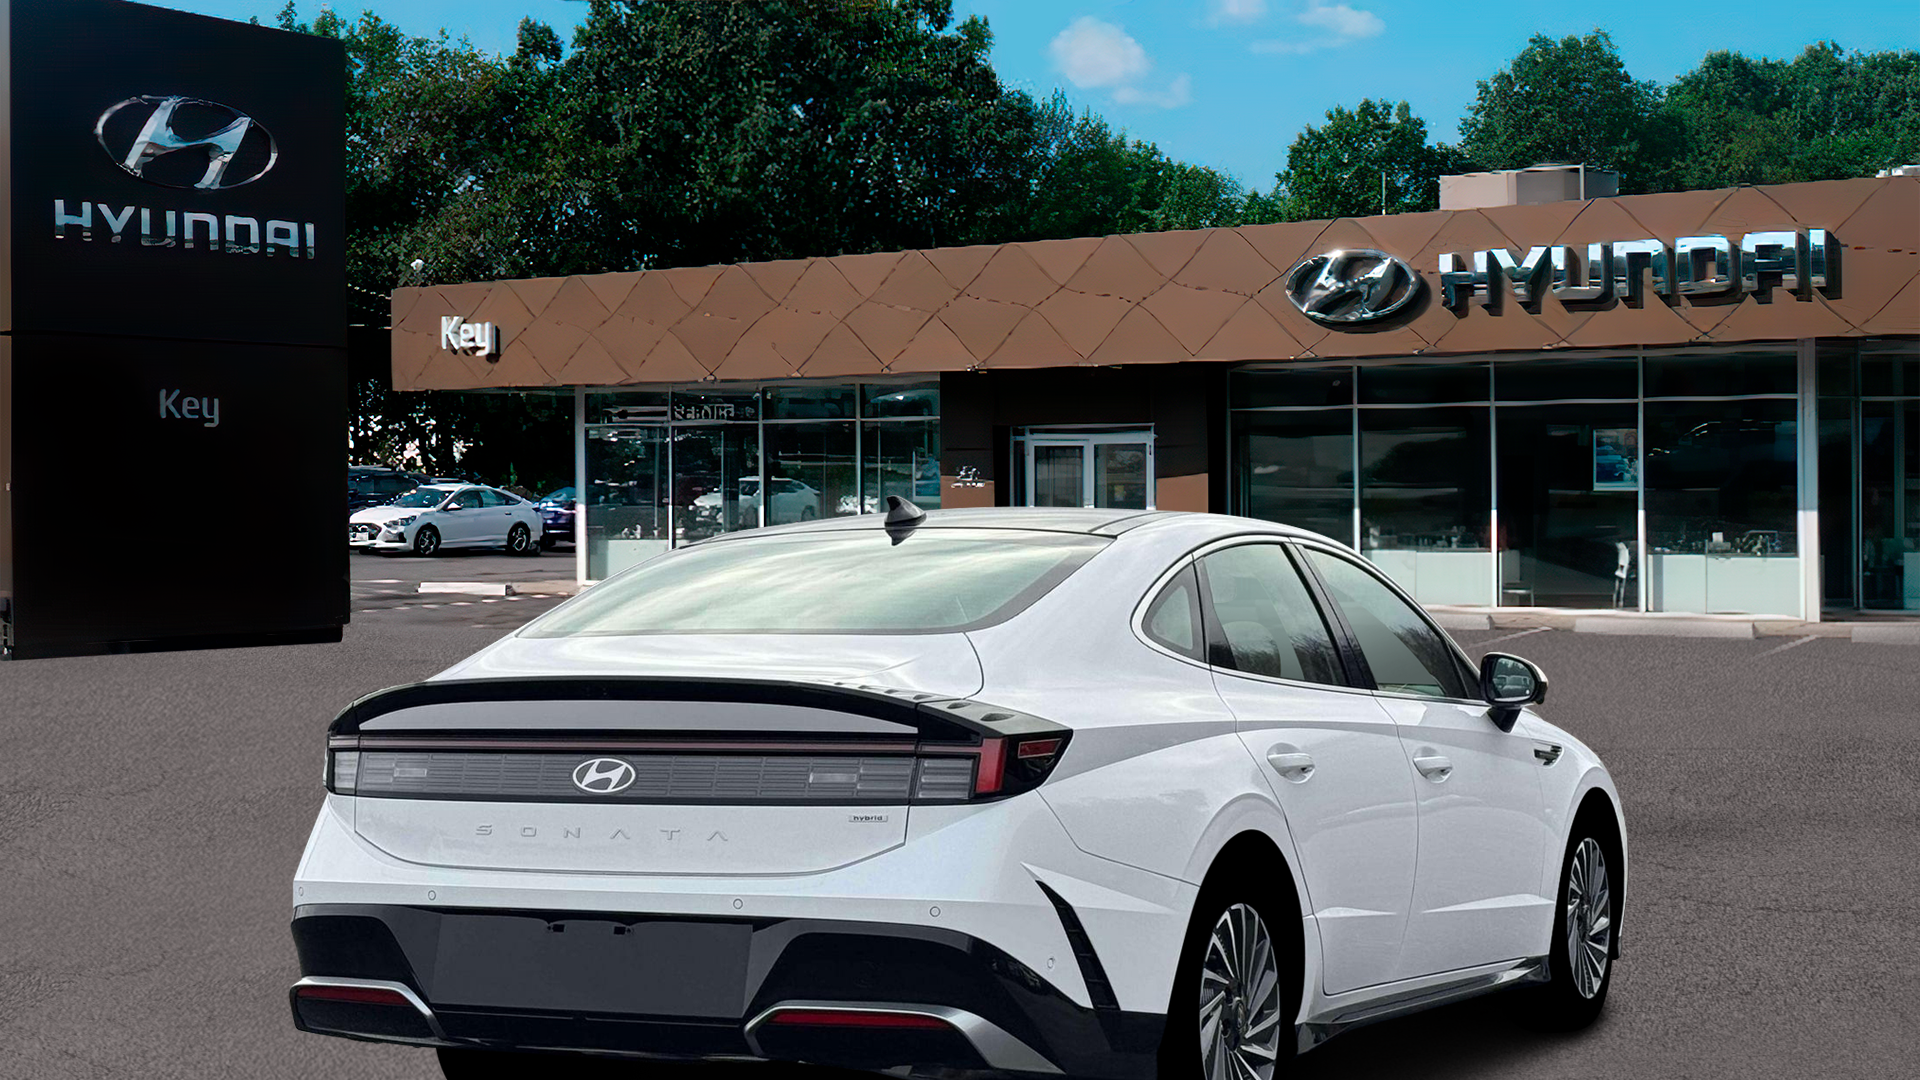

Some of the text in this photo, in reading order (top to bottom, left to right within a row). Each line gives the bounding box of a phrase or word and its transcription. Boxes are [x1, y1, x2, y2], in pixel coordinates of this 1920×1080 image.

[54, 199, 315, 259] HYUNDAI
[1438, 228, 1842, 318] HYUNDAI
[441, 315, 493, 357] Key
[158, 387, 220, 428] Key
[475, 824, 729, 842] SONATA
